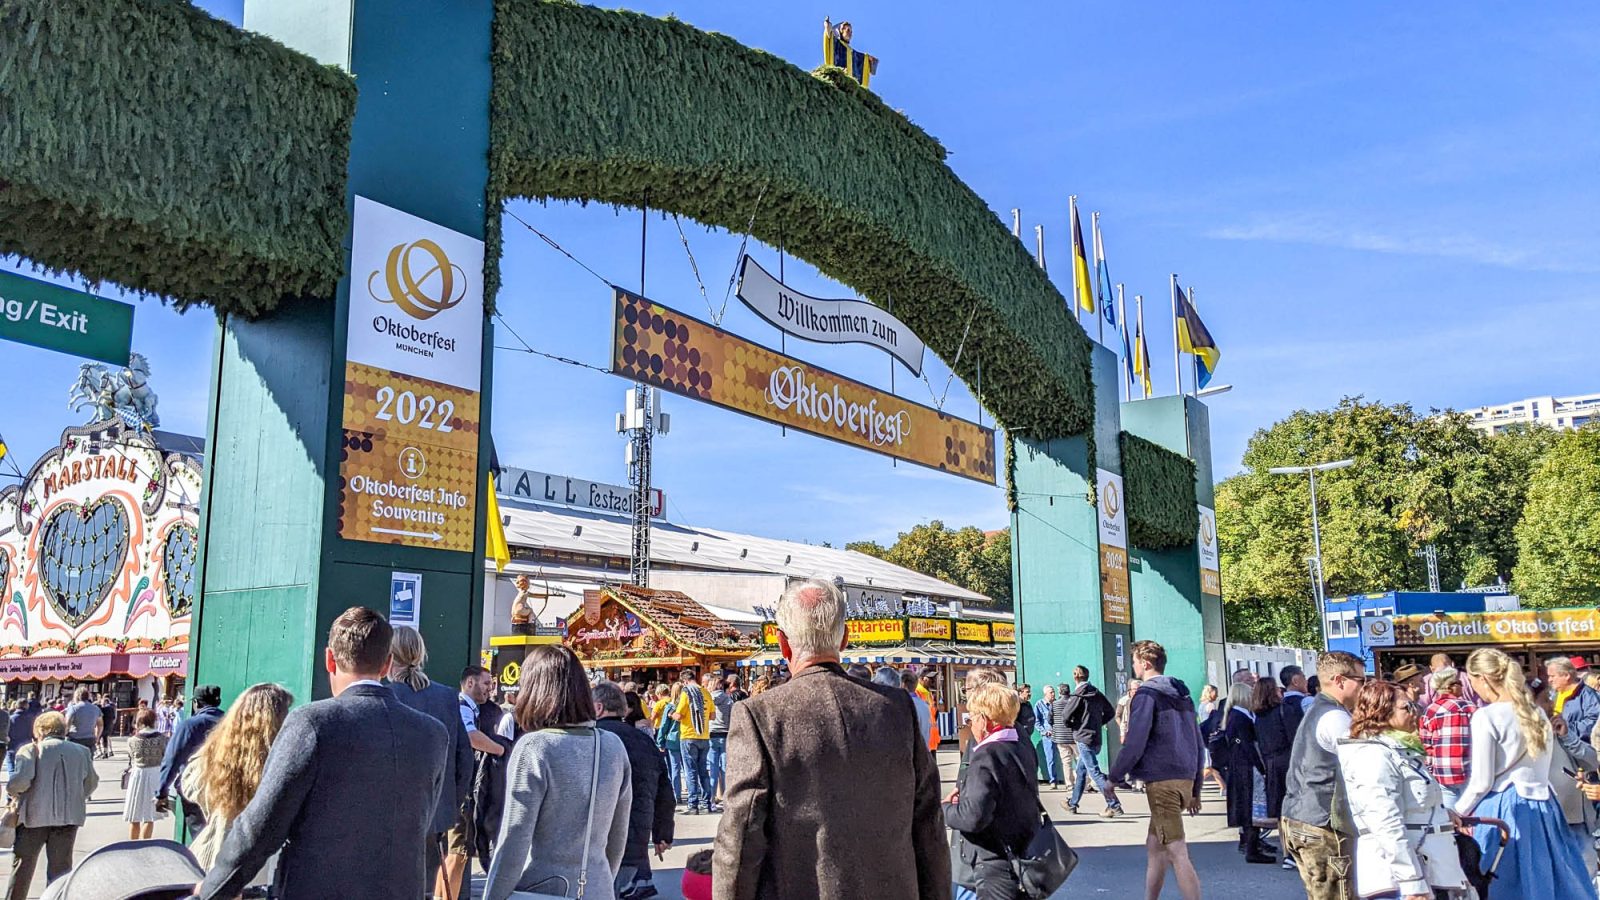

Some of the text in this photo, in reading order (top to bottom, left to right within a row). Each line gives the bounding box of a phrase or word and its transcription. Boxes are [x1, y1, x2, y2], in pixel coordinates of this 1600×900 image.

[373, 315, 456, 352] Oktoberfest
[777, 291, 898, 347] Willkommen zum
[396, 342, 434, 358] MÜNCHEN
[375, 386, 455, 433] 2022
[765, 366, 912, 447] Oktoberfest
[43, 454, 138, 499] MARSTALL
[350, 475, 467, 510] Oktoberfest Info
[372, 500, 445, 525] Souvenirs
[589, 483, 640, 515] Festzel
[1419, 616, 1595, 639] Offizielle Oktoberfest
[149, 655, 182, 669] Kaffeebar
